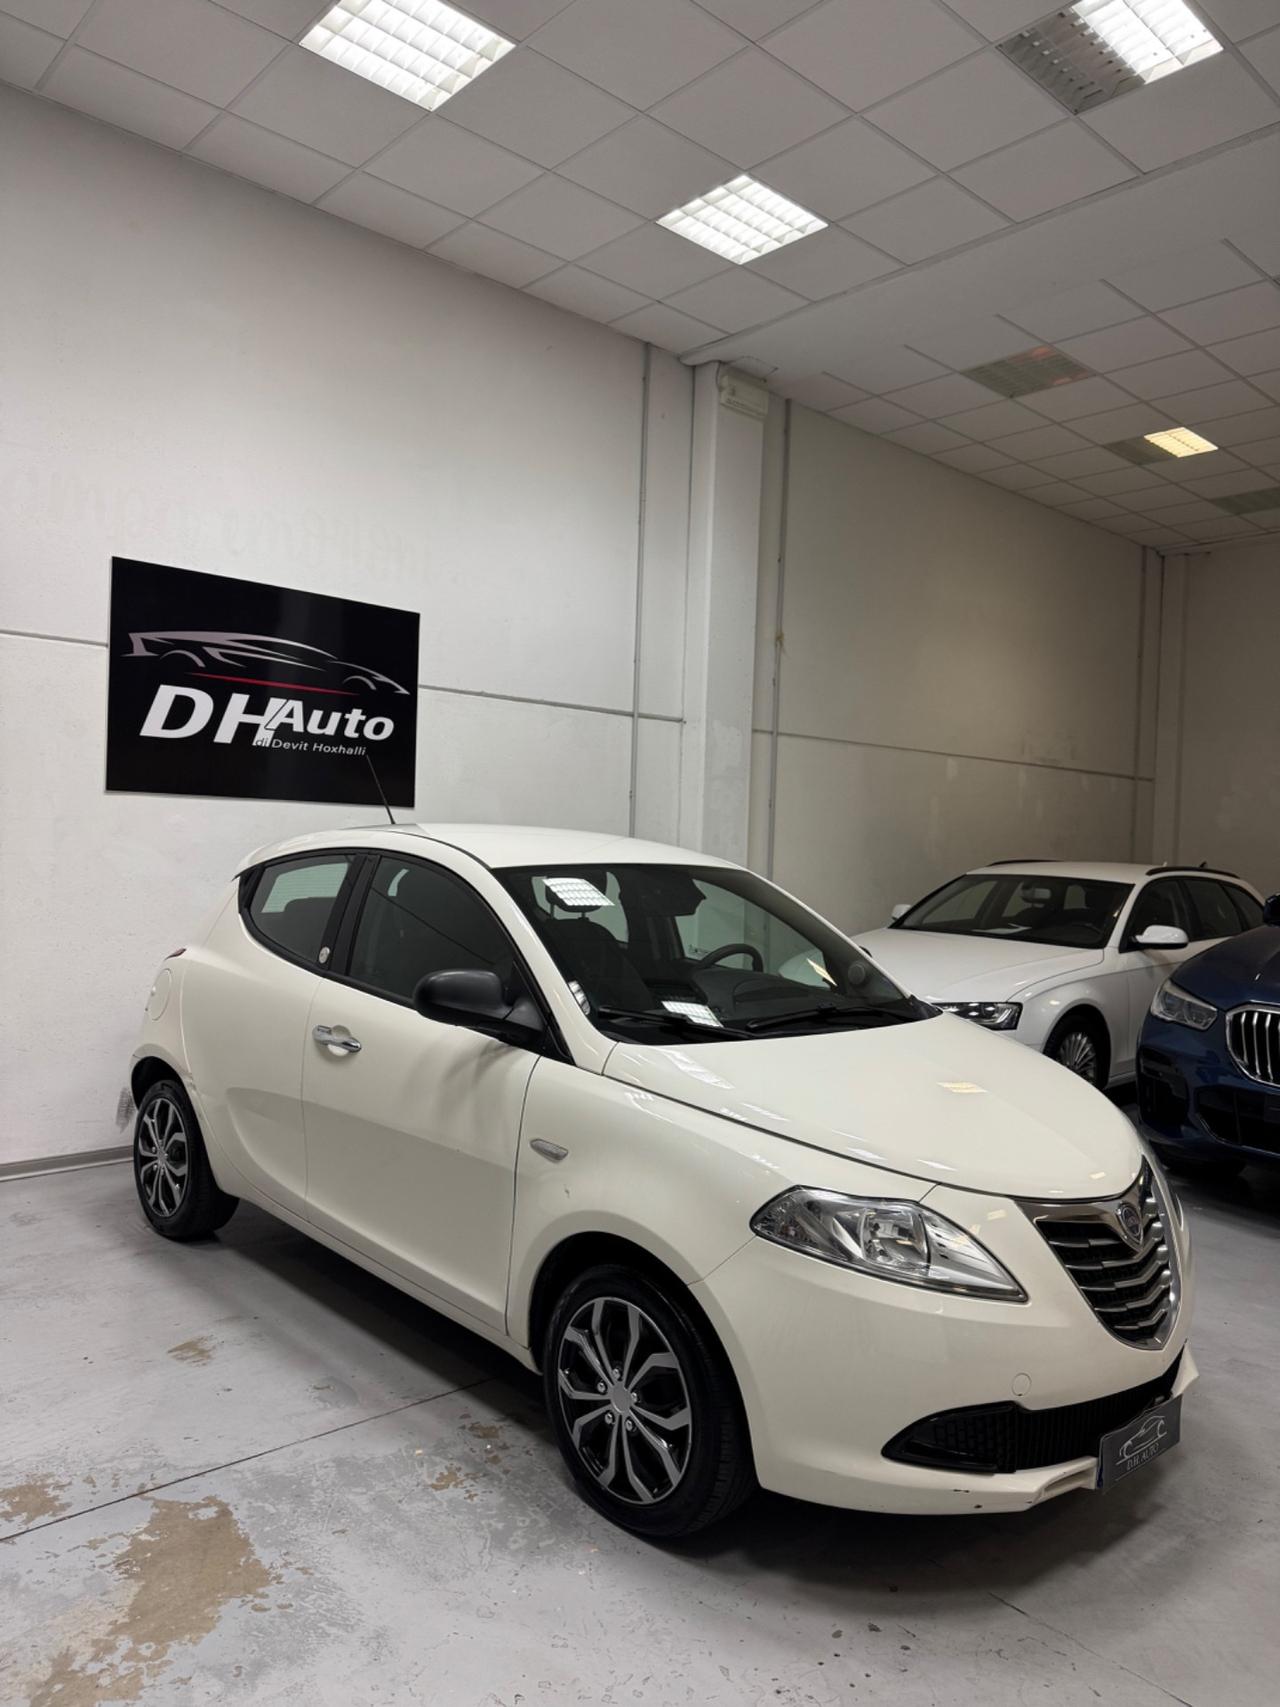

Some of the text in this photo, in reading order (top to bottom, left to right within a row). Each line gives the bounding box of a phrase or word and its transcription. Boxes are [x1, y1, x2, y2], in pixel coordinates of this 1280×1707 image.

[140, 684, 395, 746] DH Auto
[271, 739, 309, 751] Devit
[312, 743, 367, 756] Hoxhalli
[1140, 1443, 1160, 1464] AUTO
